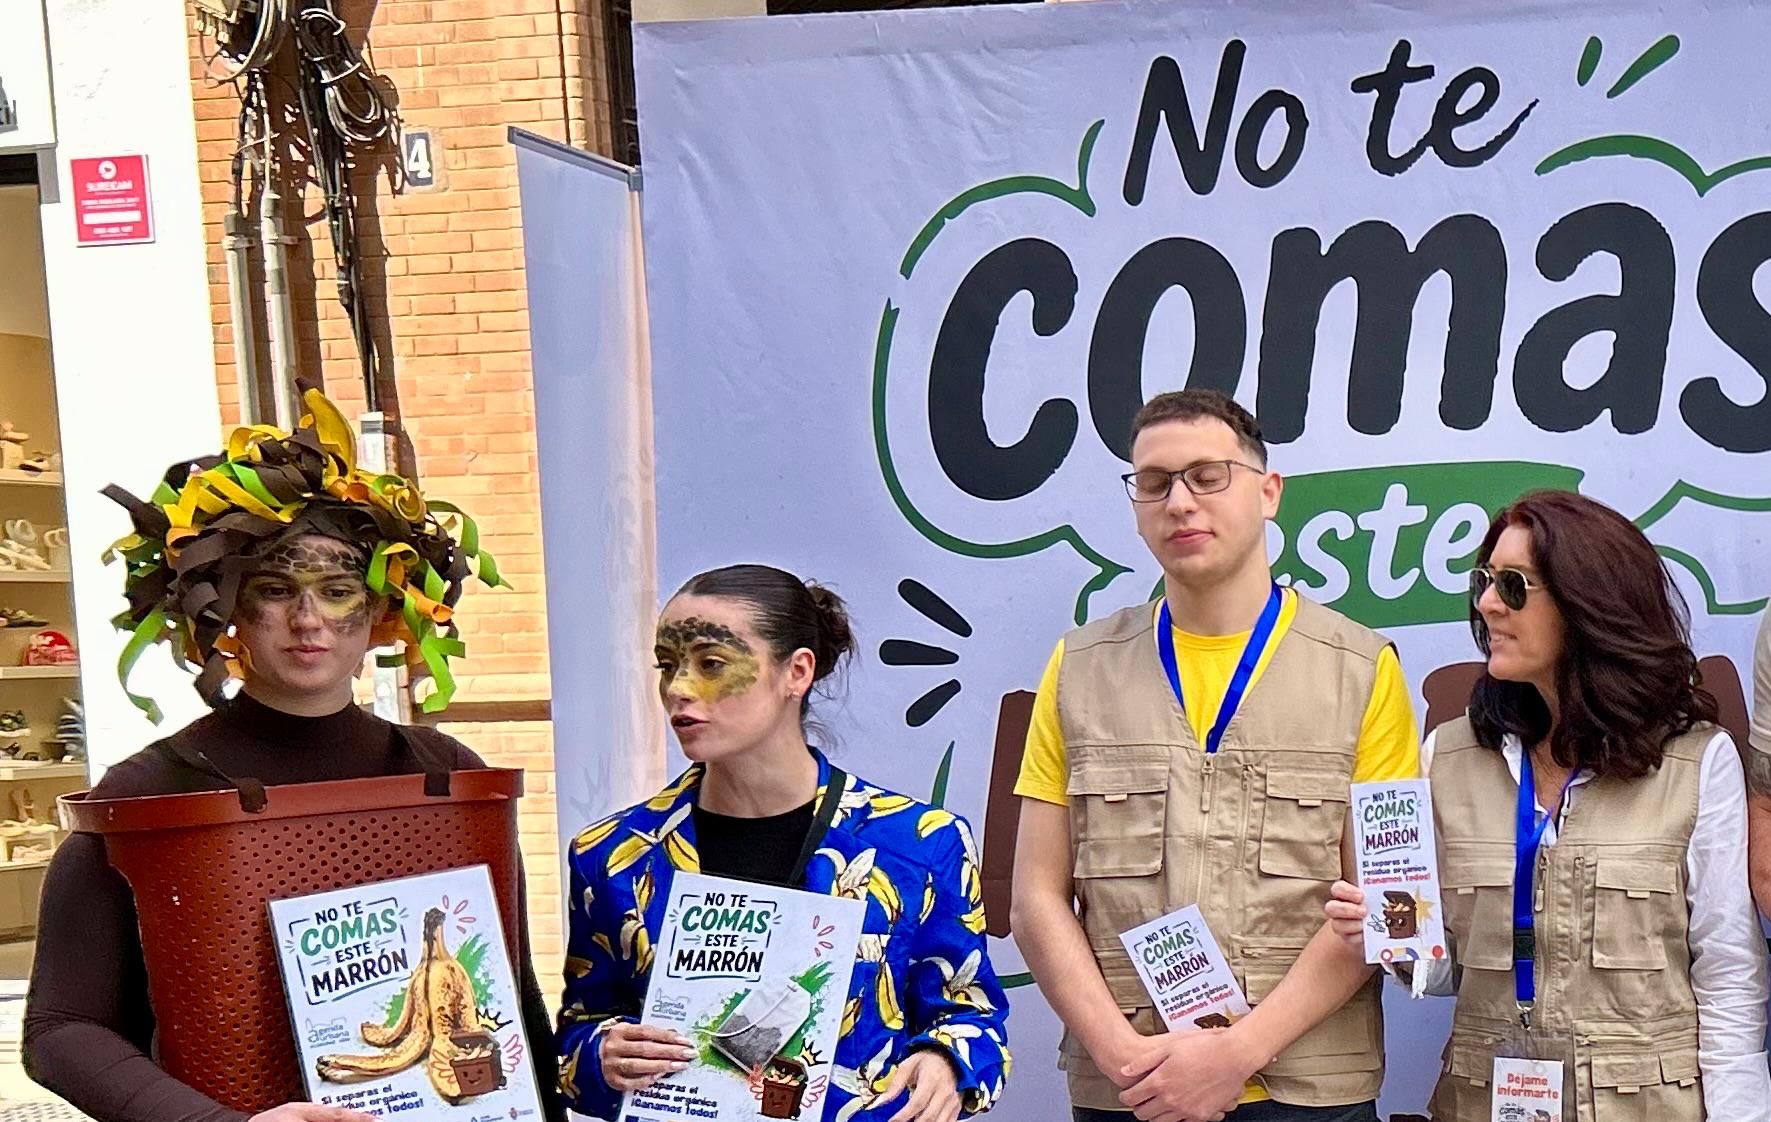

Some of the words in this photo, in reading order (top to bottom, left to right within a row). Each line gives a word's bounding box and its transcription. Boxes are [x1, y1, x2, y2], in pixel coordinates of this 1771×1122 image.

[1123, 39, 1309, 206] No
[1351, 39, 1539, 176] te
[409, 138, 432, 179] 4
[1372, 792, 1384, 802] NO
[1386, 790, 1397, 800] TE
[1364, 799, 1415, 822] COMAS
[1365, 824, 1419, 851] MARRÓN
[1379, 819, 1399, 831] ESTE
[704, 892, 725, 907] NO
[730, 894, 748, 907] TE
[315, 908, 338, 925] NO
[342, 901, 363, 917] TE
[681, 906, 771, 934] COMAS
[301, 908, 398, 956] COMAS
[705, 934, 739, 947] ESTE
[1145, 931, 1159, 945] NO
[1159, 925, 1171, 937] TE
[335, 941, 372, 963] ESTE
[1143, 928, 1195, 965] COMAS
[1163, 950, 1186, 967] ESTE
[674, 946, 764, 973] MARRÓN
[1154, 951, 1210, 990] MARRÓN
[312, 948, 408, 997] MARRÓN
